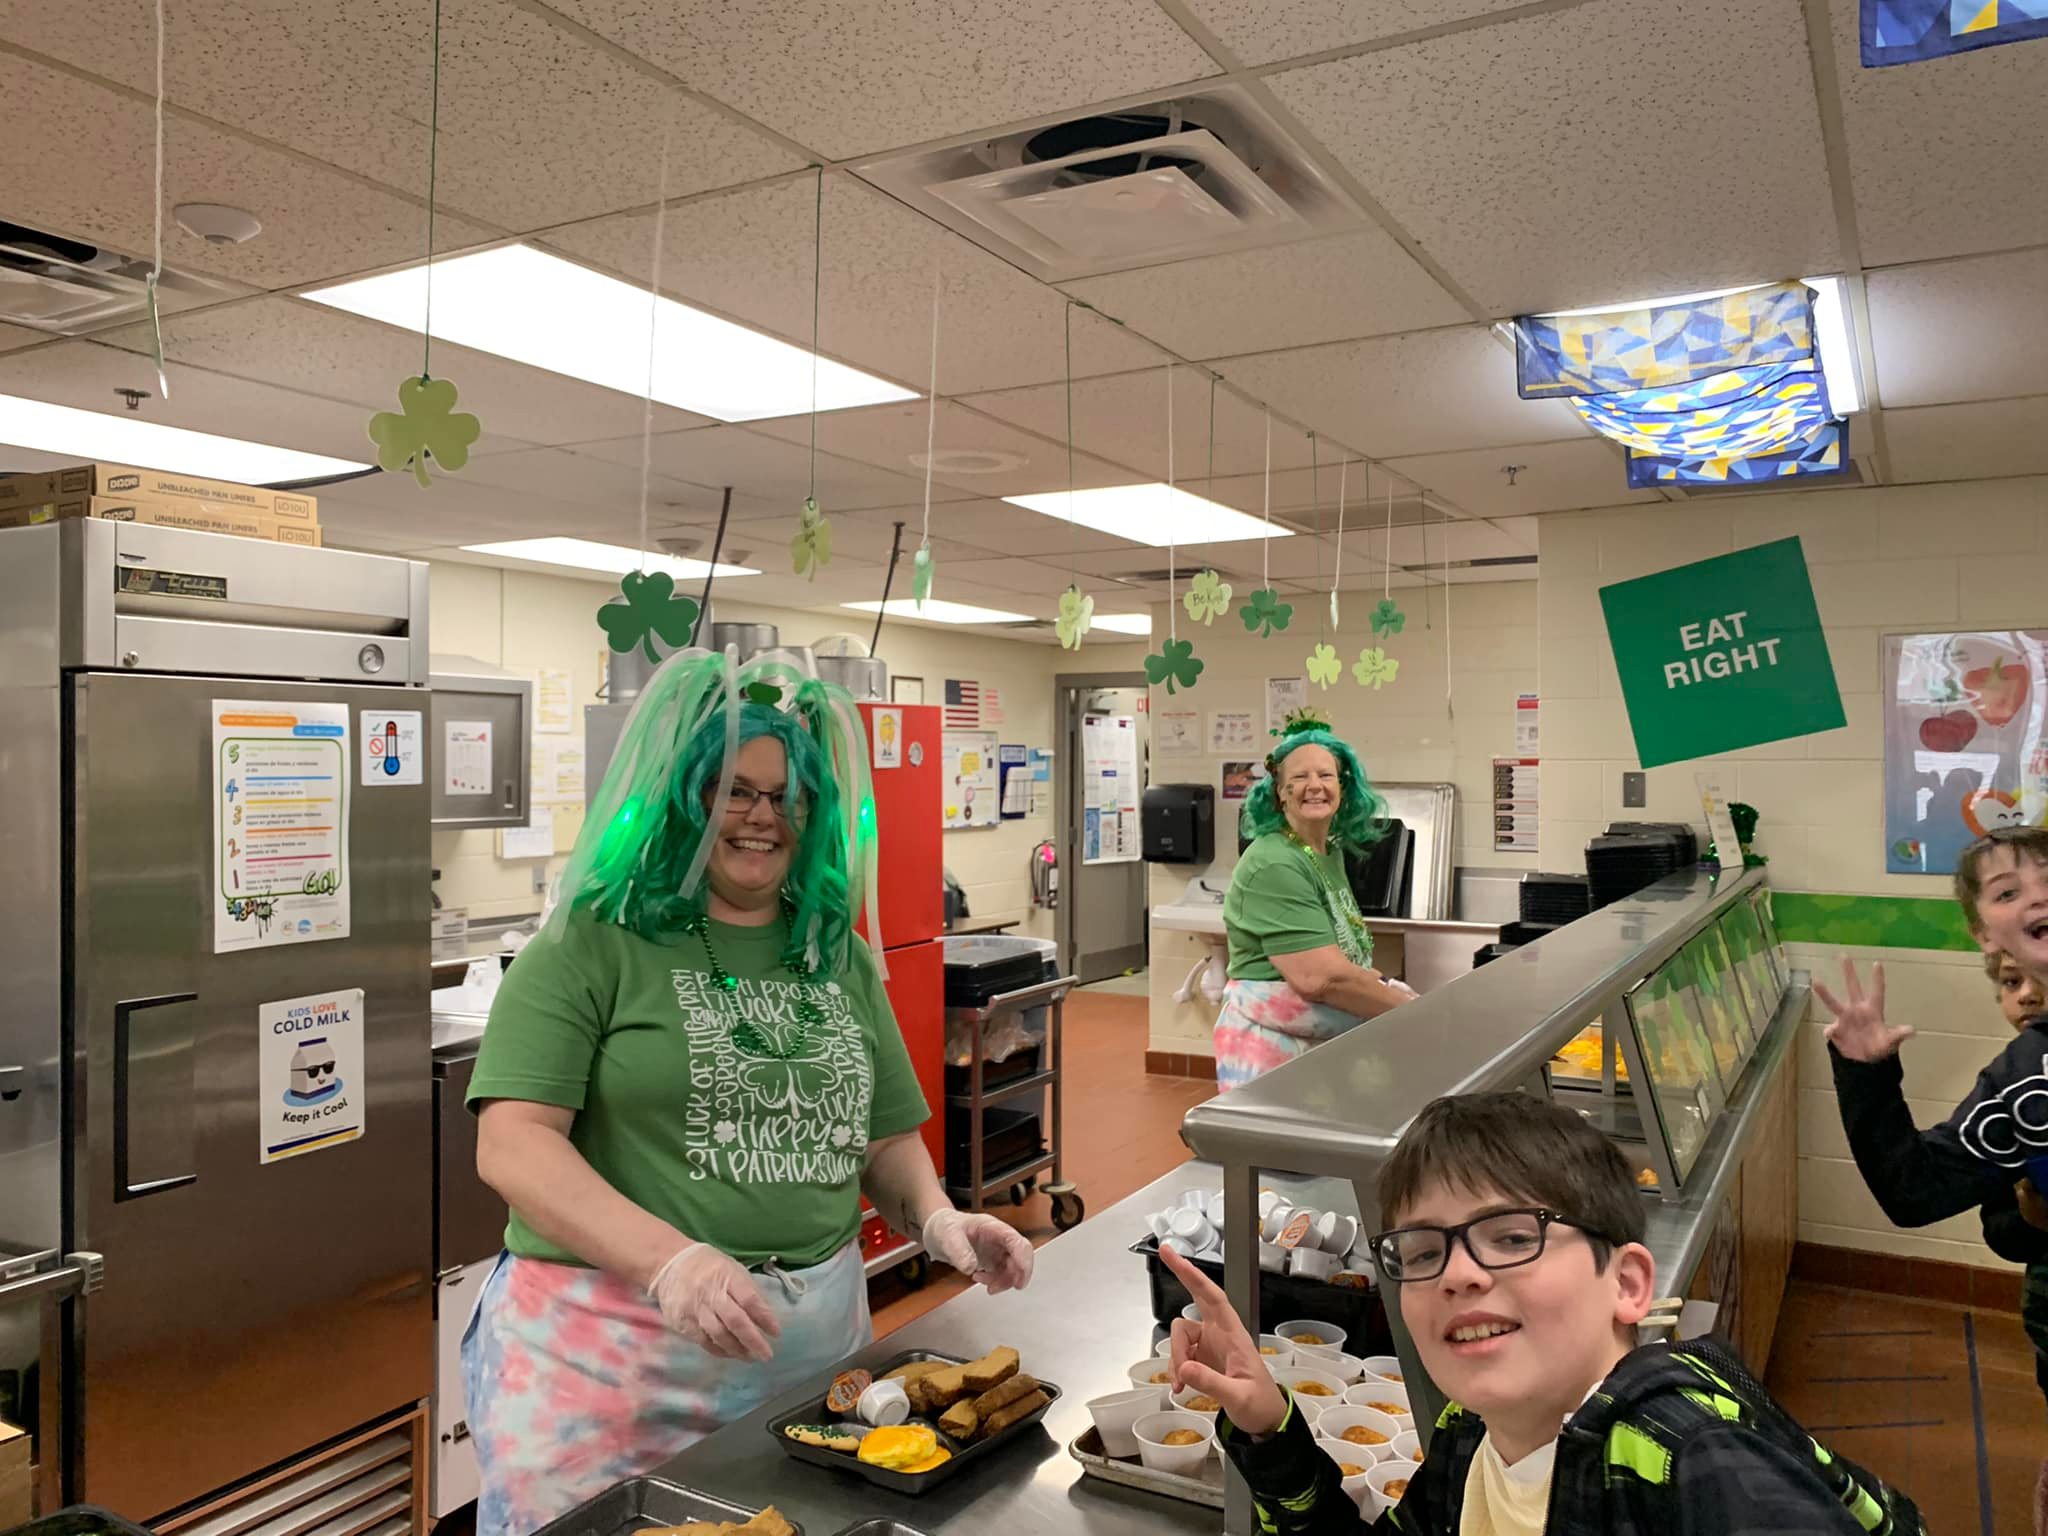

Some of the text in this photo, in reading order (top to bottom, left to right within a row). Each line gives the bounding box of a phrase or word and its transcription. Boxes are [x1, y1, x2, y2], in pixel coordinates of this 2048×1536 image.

[157, 482, 256, 504] UNBLEACHED PAN LINERS
[154, 513, 258, 534] UNBLEACHED PAN LINERS
[1679, 611, 1748, 652] EAT
[1663, 638, 1781, 689] RIGHT
[228, 743, 240, 764] 5
[225, 778, 239, 803] 4
[232, 805, 242, 825] 3
[227, 838, 241, 858] 2
[303, 869, 336, 896] GO!
[273, 1010, 350, 1035] COLD MILK
[287, 1002, 337, 1018] KIDS LOVE
[689, 1058, 715, 1089] OF
[282, 1098, 348, 1124] Keep it Cool
[685, 1093, 712, 1147] LUCK
[737, 1114, 834, 1152] HAPPY
[685, 1148, 721, 1181] ST
